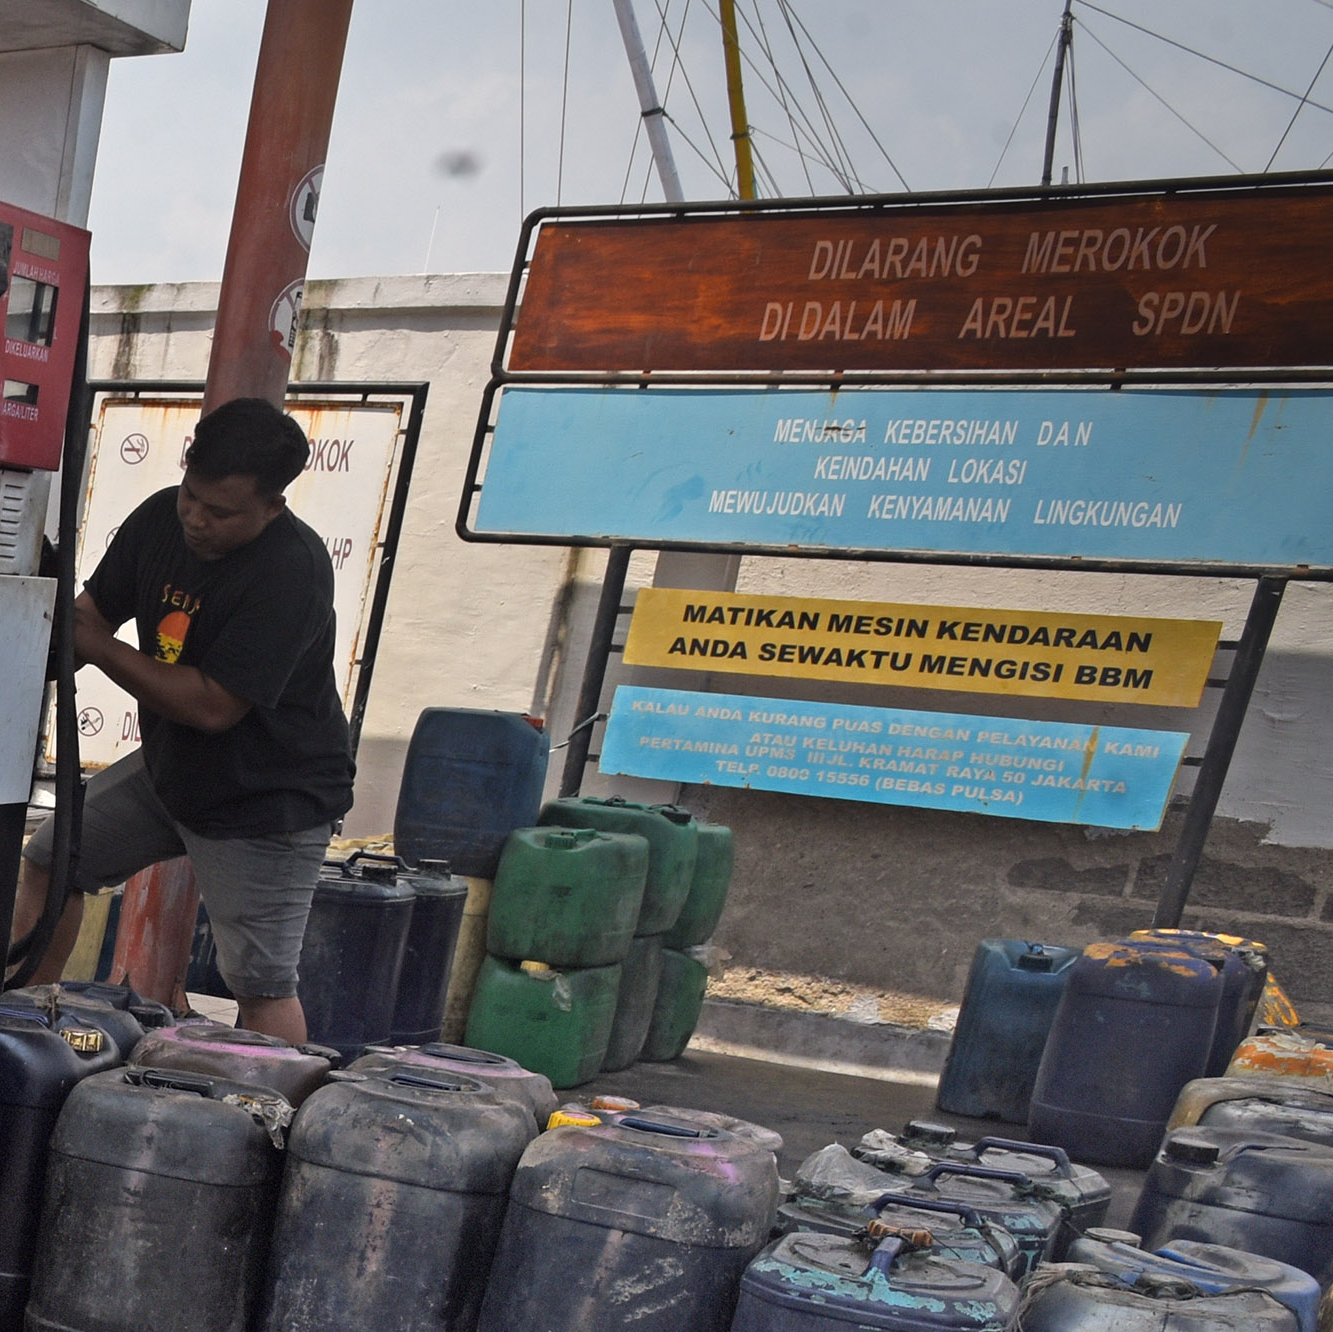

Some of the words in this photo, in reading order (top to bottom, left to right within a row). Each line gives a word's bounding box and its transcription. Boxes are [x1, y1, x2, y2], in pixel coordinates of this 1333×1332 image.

[807, 234, 982, 280] DILARANG
[1021, 224, 1218, 274] MEROKOK
[758, 302, 794, 341] DI
[797, 299, 917, 341] DALAM
[957, 296, 1077, 340] AREAL
[1132, 290, 1241, 336] SPDN
[773, 418, 866, 443] MENJAGA
[884, 419, 1019, 445] KEBERSIHAN
[1037, 421, 1093, 446] DAN
[814, 455, 931, 481] KEINDAHAN
[948, 459, 1027, 485] LOKASI
[708, 490, 846, 517] MEWUJUDKAN
[867, 495, 1011, 523] KENYAMANAN
[1034, 499, 1182, 528] LINGKUNGAN
[683, 604, 820, 631] MATIKAN
[827, 613, 929, 638] MESIN
[936, 620, 1153, 653] KENDARAAN
[668, 637, 747, 660] ANDA
[758, 642, 912, 672] SEWAKTU
[919, 654, 1063, 683] MENGISI
[1074, 665, 1154, 689] BBM
[631, 700, 690, 716] KALAU
[695, 706, 743, 721] ANDA
[748, 711, 826, 729] KURANG
[832, 719, 882, 734] PUAS
[888, 723, 971, 742] DENGAN
[977, 731, 1097, 752] PELAYANAN
[1104, 741, 1160, 758] KAMI
[750, 733, 797, 747] ATAU
[802, 737, 893, 757] KELUHAN
[896, 746, 964, 762] HARAP
[969, 753, 1065, 772] HUBUNGI
[638, 736, 739, 755] PERTAMINA
[745, 746, 796, 761] UPMS
[859, 757, 938, 775] KRAMAT
[946, 765, 996, 781] RAYA
[1002, 771, 1026, 784] 50
[1031, 774, 1127, 794] JAKARTA
[816, 771, 870, 787] 15556
[875, 777, 945, 795] (BEBAS
[951, 785, 1024, 805] PULSA)
